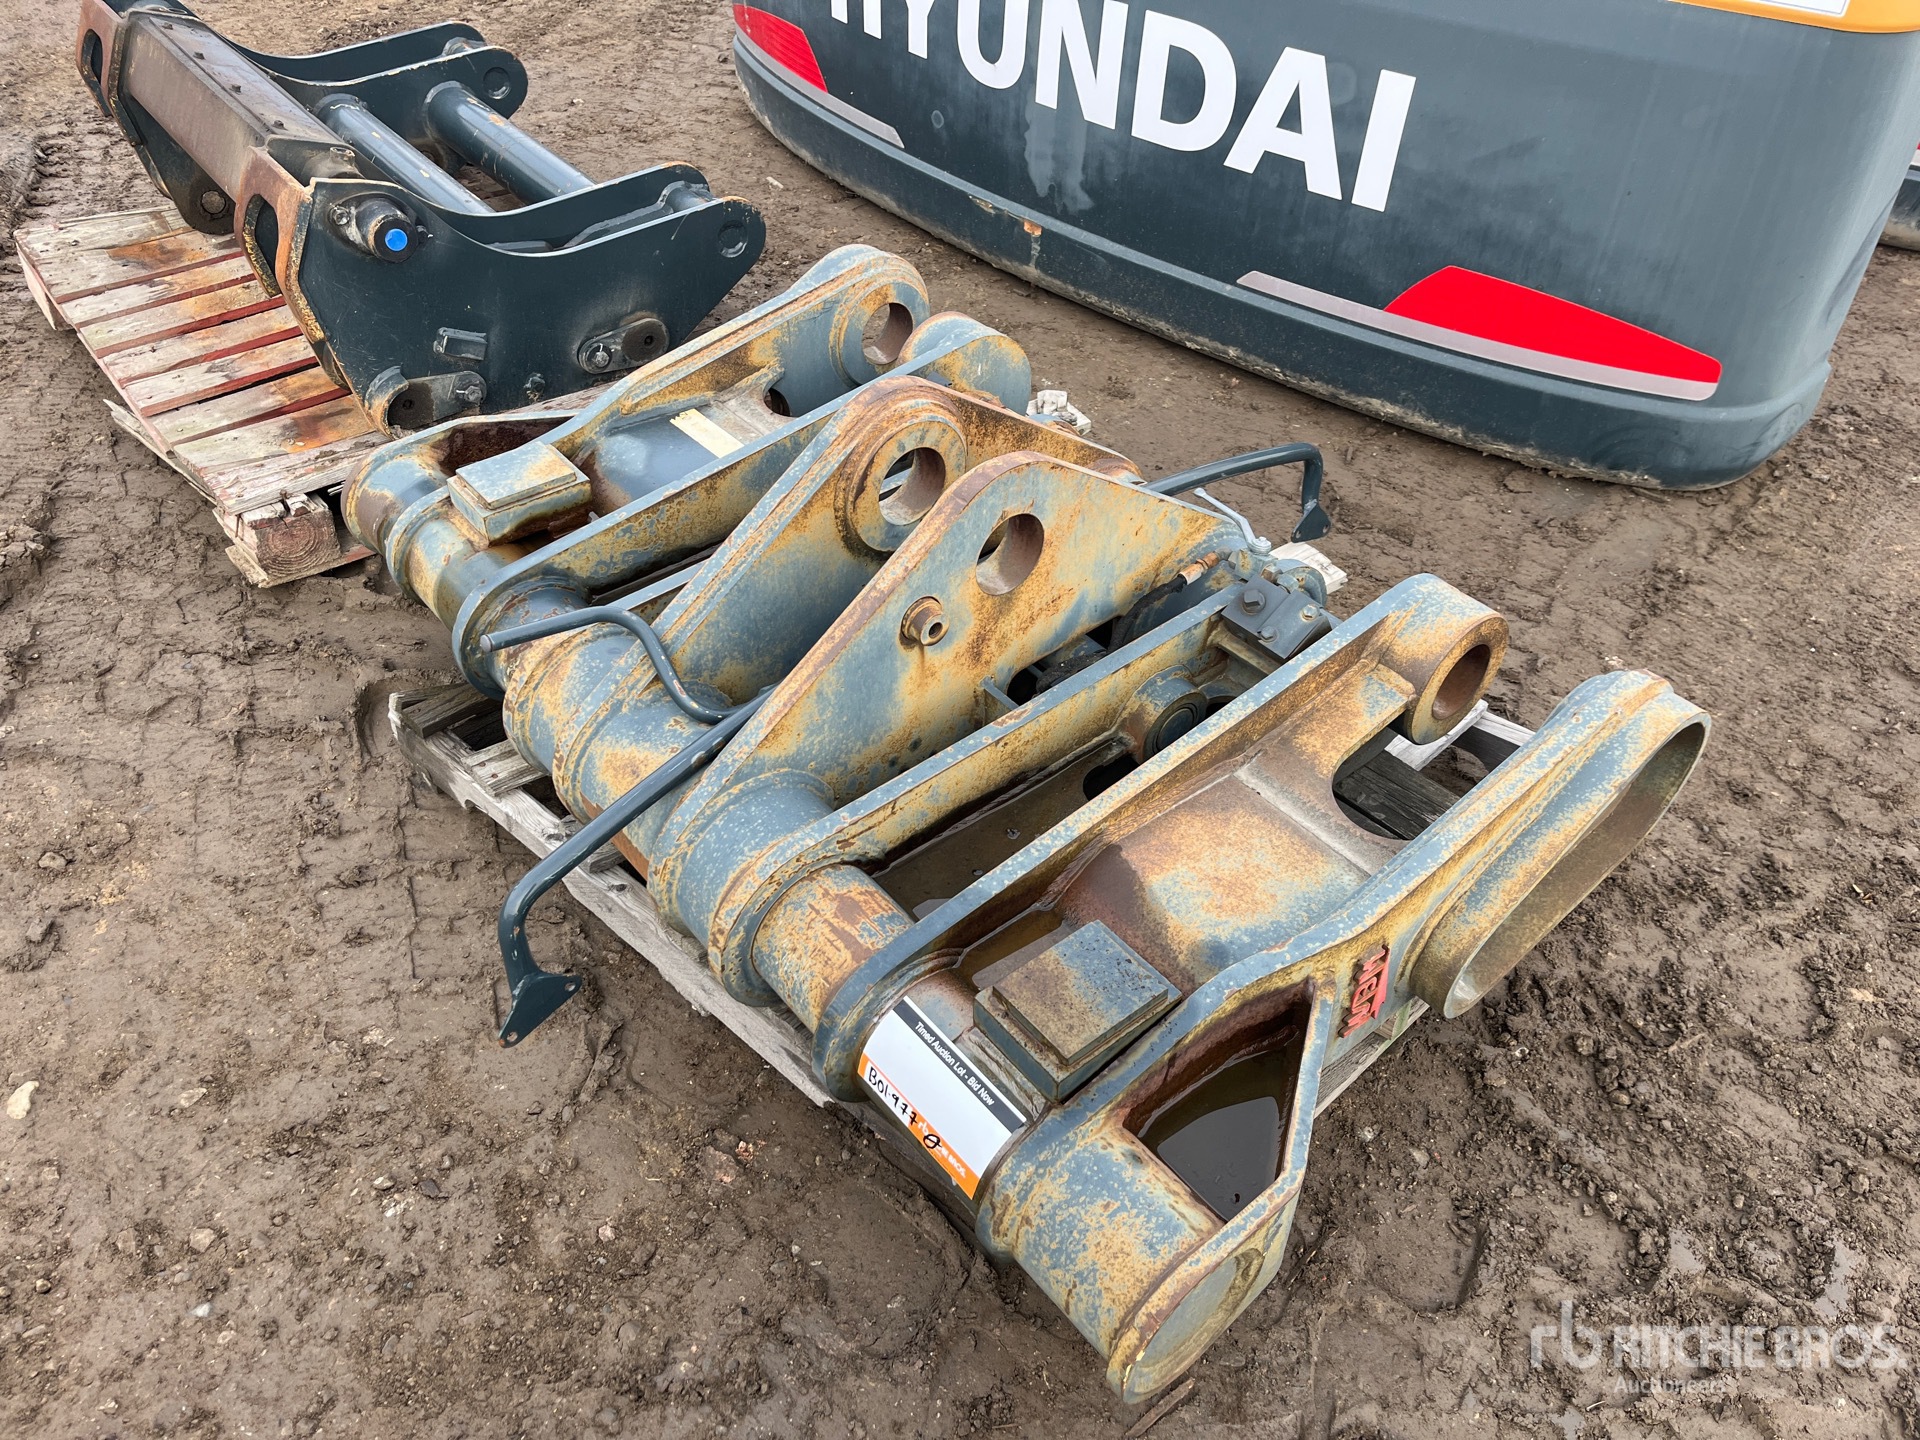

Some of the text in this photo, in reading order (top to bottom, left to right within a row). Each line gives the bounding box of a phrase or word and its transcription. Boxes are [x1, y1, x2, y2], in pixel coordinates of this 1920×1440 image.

[915, 1021, 936, 1044] Timed
[931, 1041, 955, 1066] Auction
[953, 1062, 967, 1077] Lot
[967, 1076, 982, 1092] Bid
[977, 1087, 995, 1106] Now
